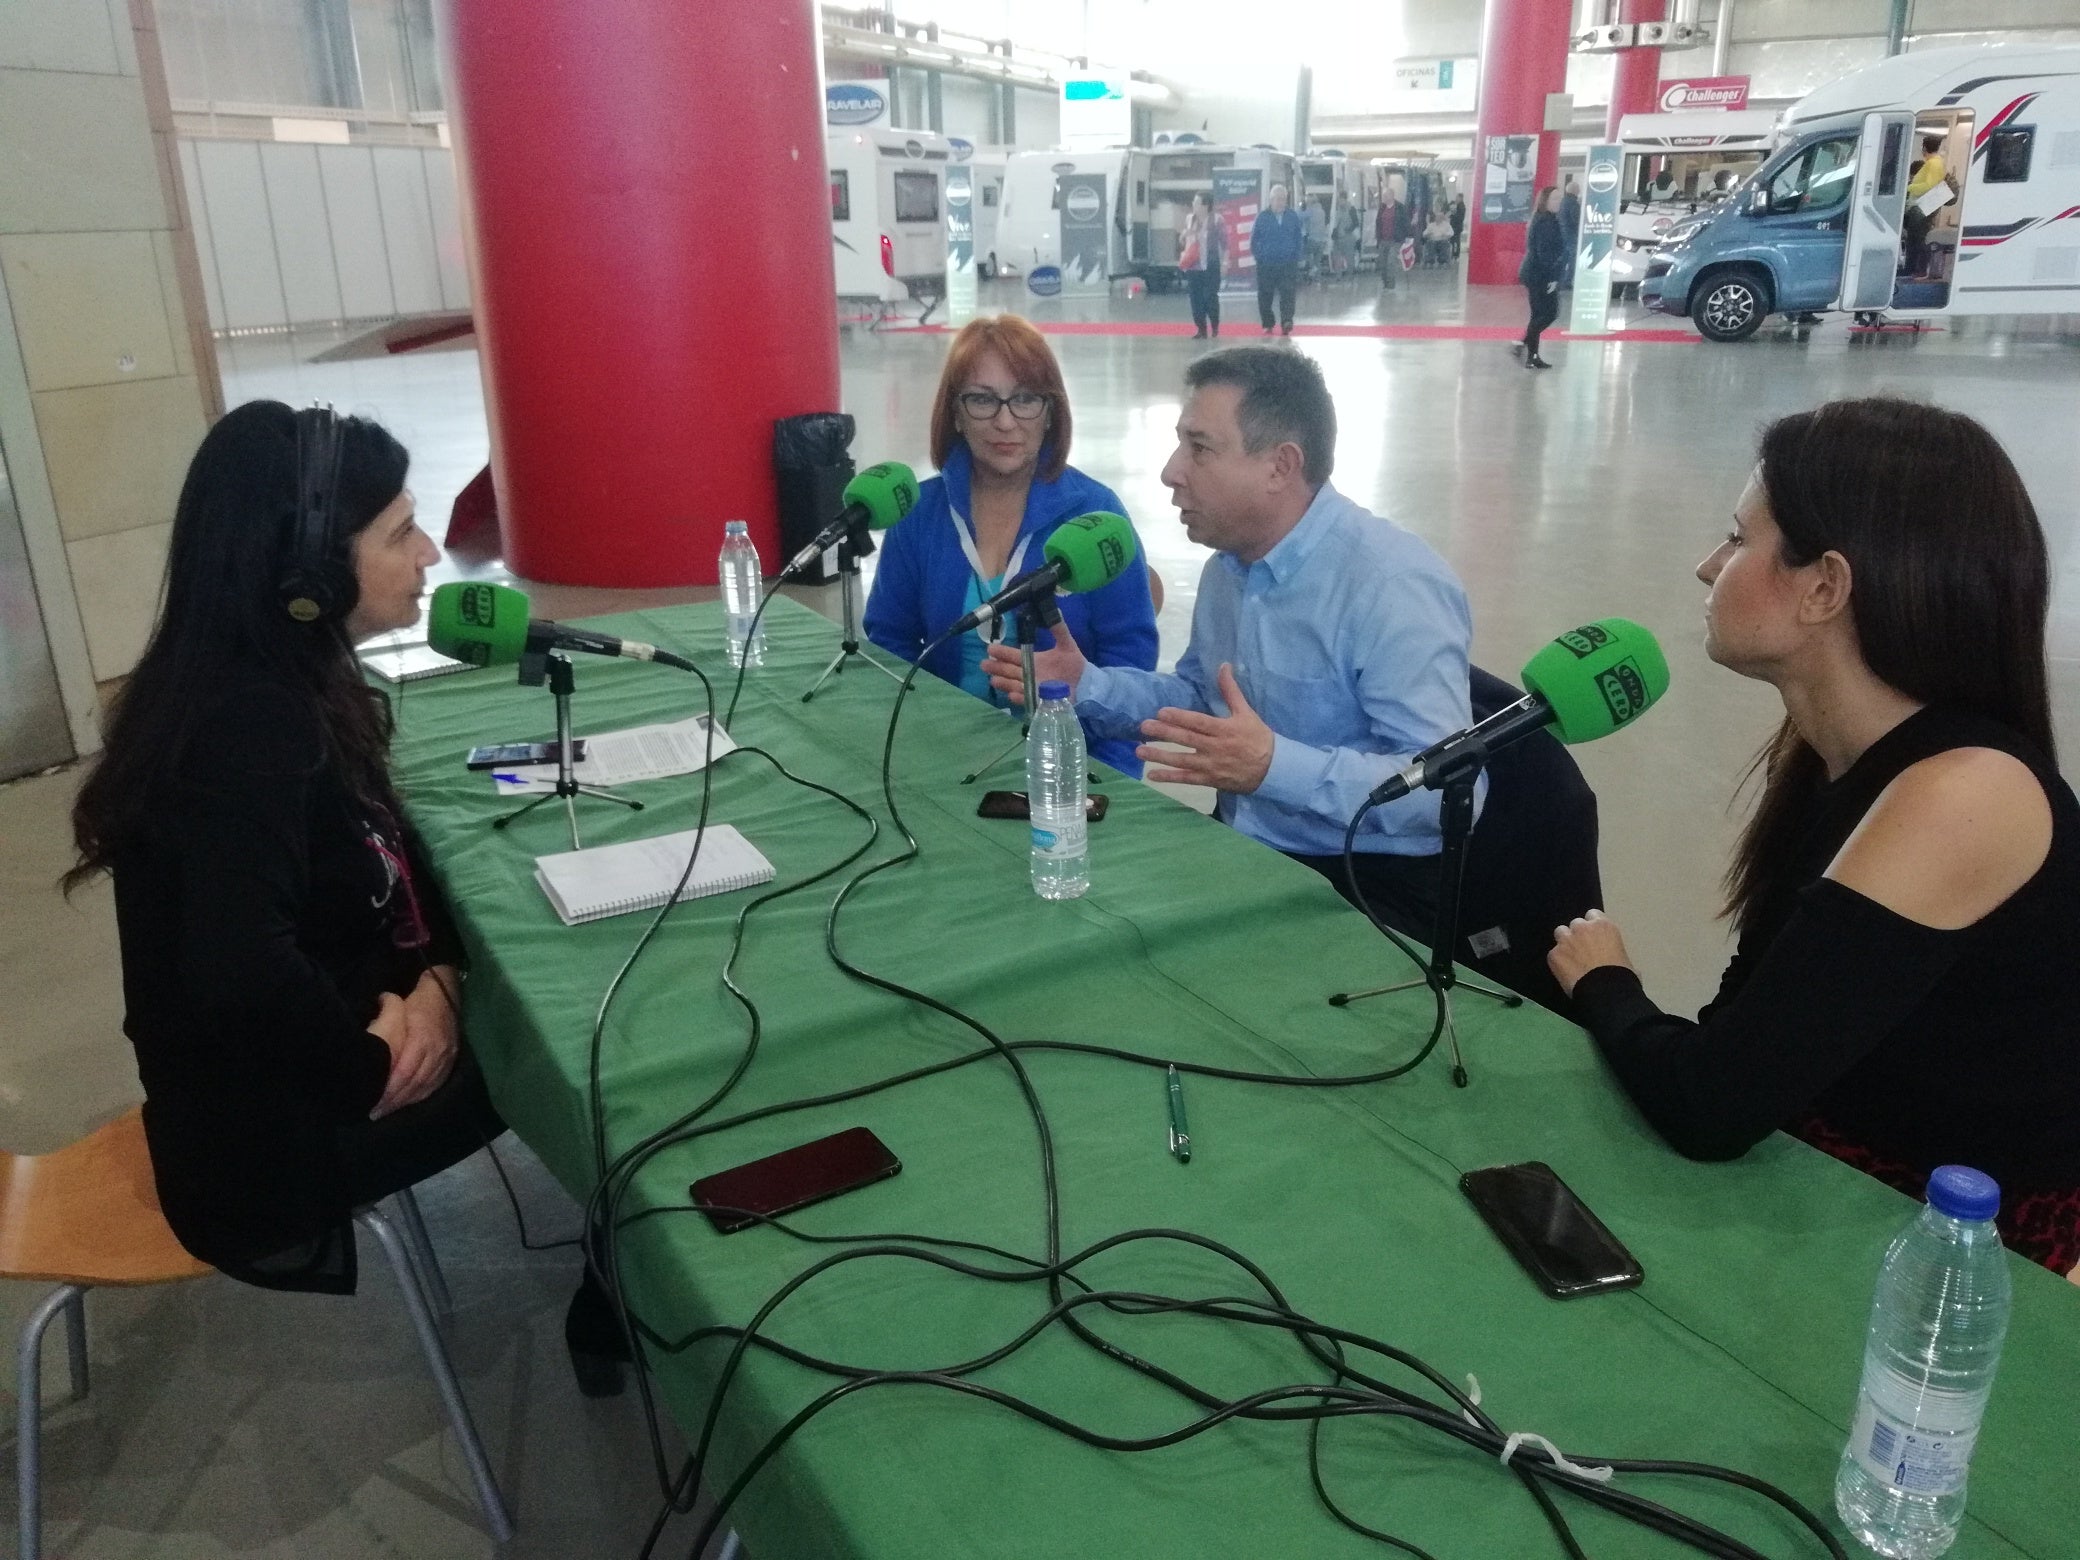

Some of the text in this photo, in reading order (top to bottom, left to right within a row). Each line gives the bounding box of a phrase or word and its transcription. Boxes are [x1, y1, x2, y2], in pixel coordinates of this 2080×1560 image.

[1396, 67, 1435, 77] OFICINAS
[828, 100, 882, 110] RAVELAIR
[1586, 202, 1613, 224] Vive
[1608, 680, 1628, 714] CERO
